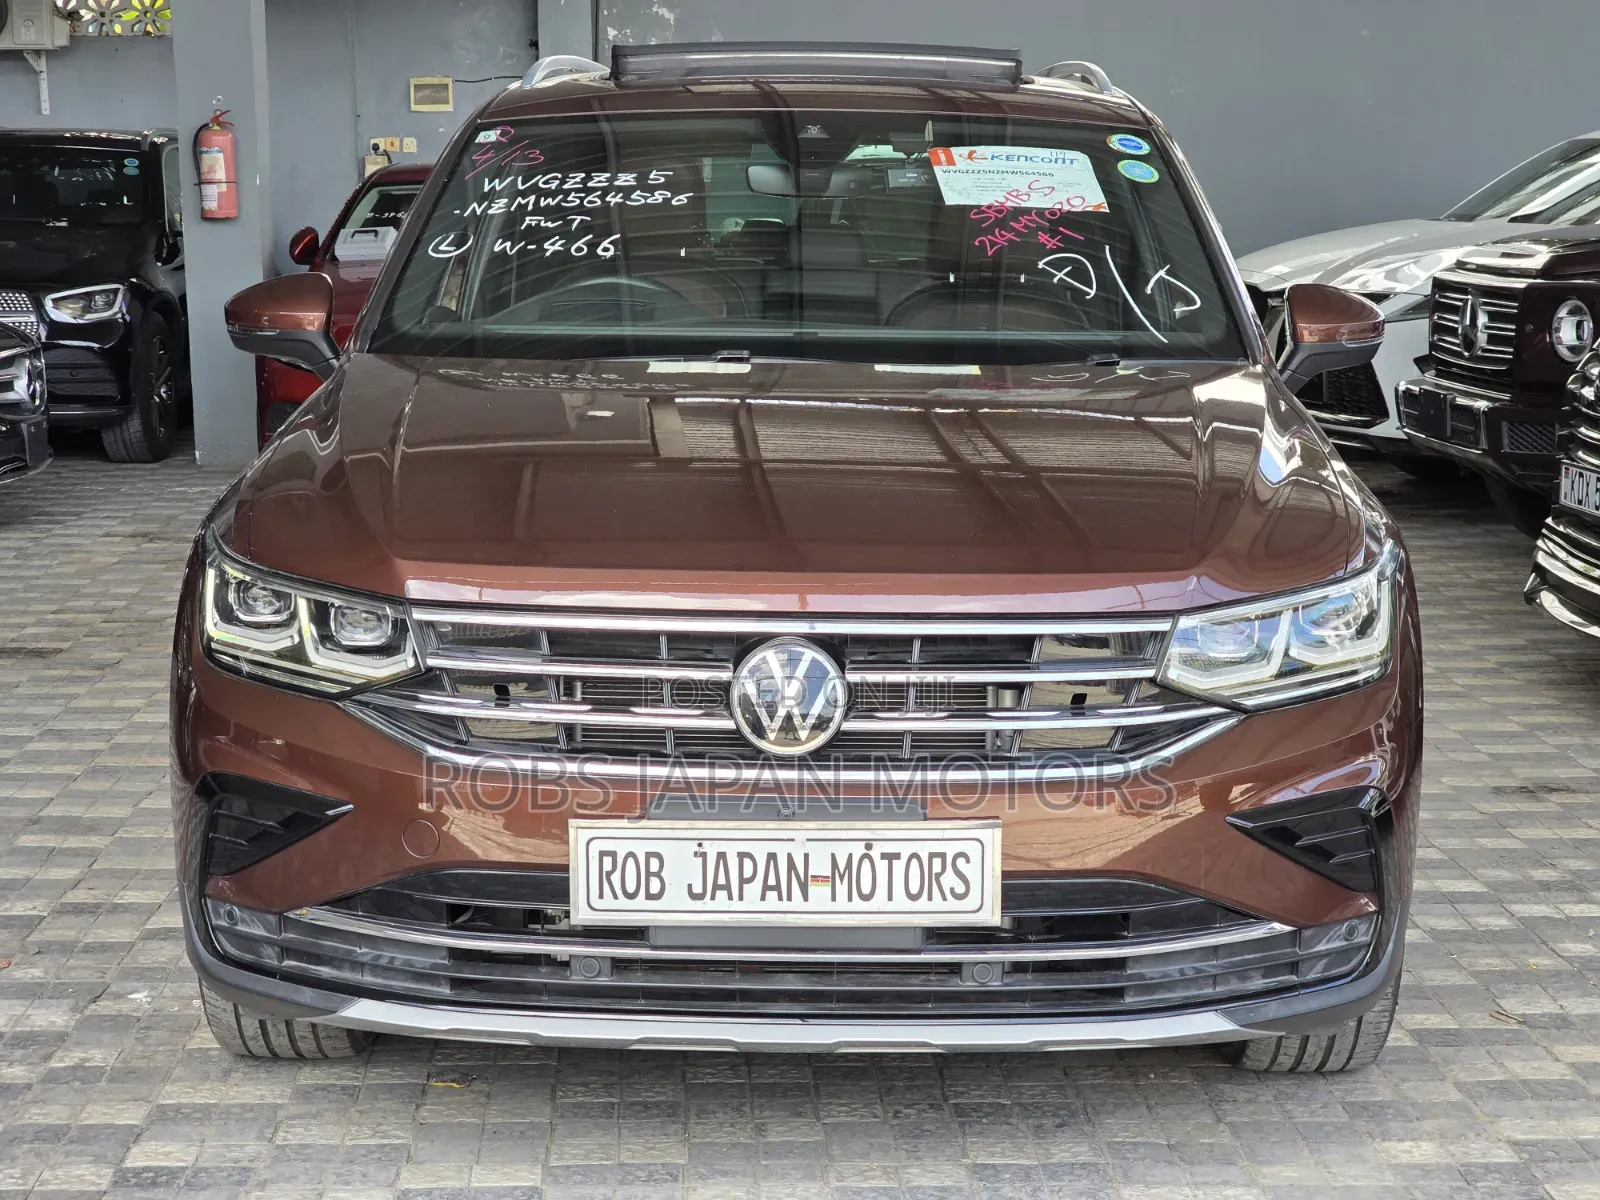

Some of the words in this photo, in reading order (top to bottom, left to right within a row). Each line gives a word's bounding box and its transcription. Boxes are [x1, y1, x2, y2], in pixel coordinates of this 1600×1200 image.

[1570, 469, 1591, 509] KDX
[598, 850, 665, 900] ROB
[687, 850, 810, 902] JAPAN
[830, 850, 971, 902] MOTORS
